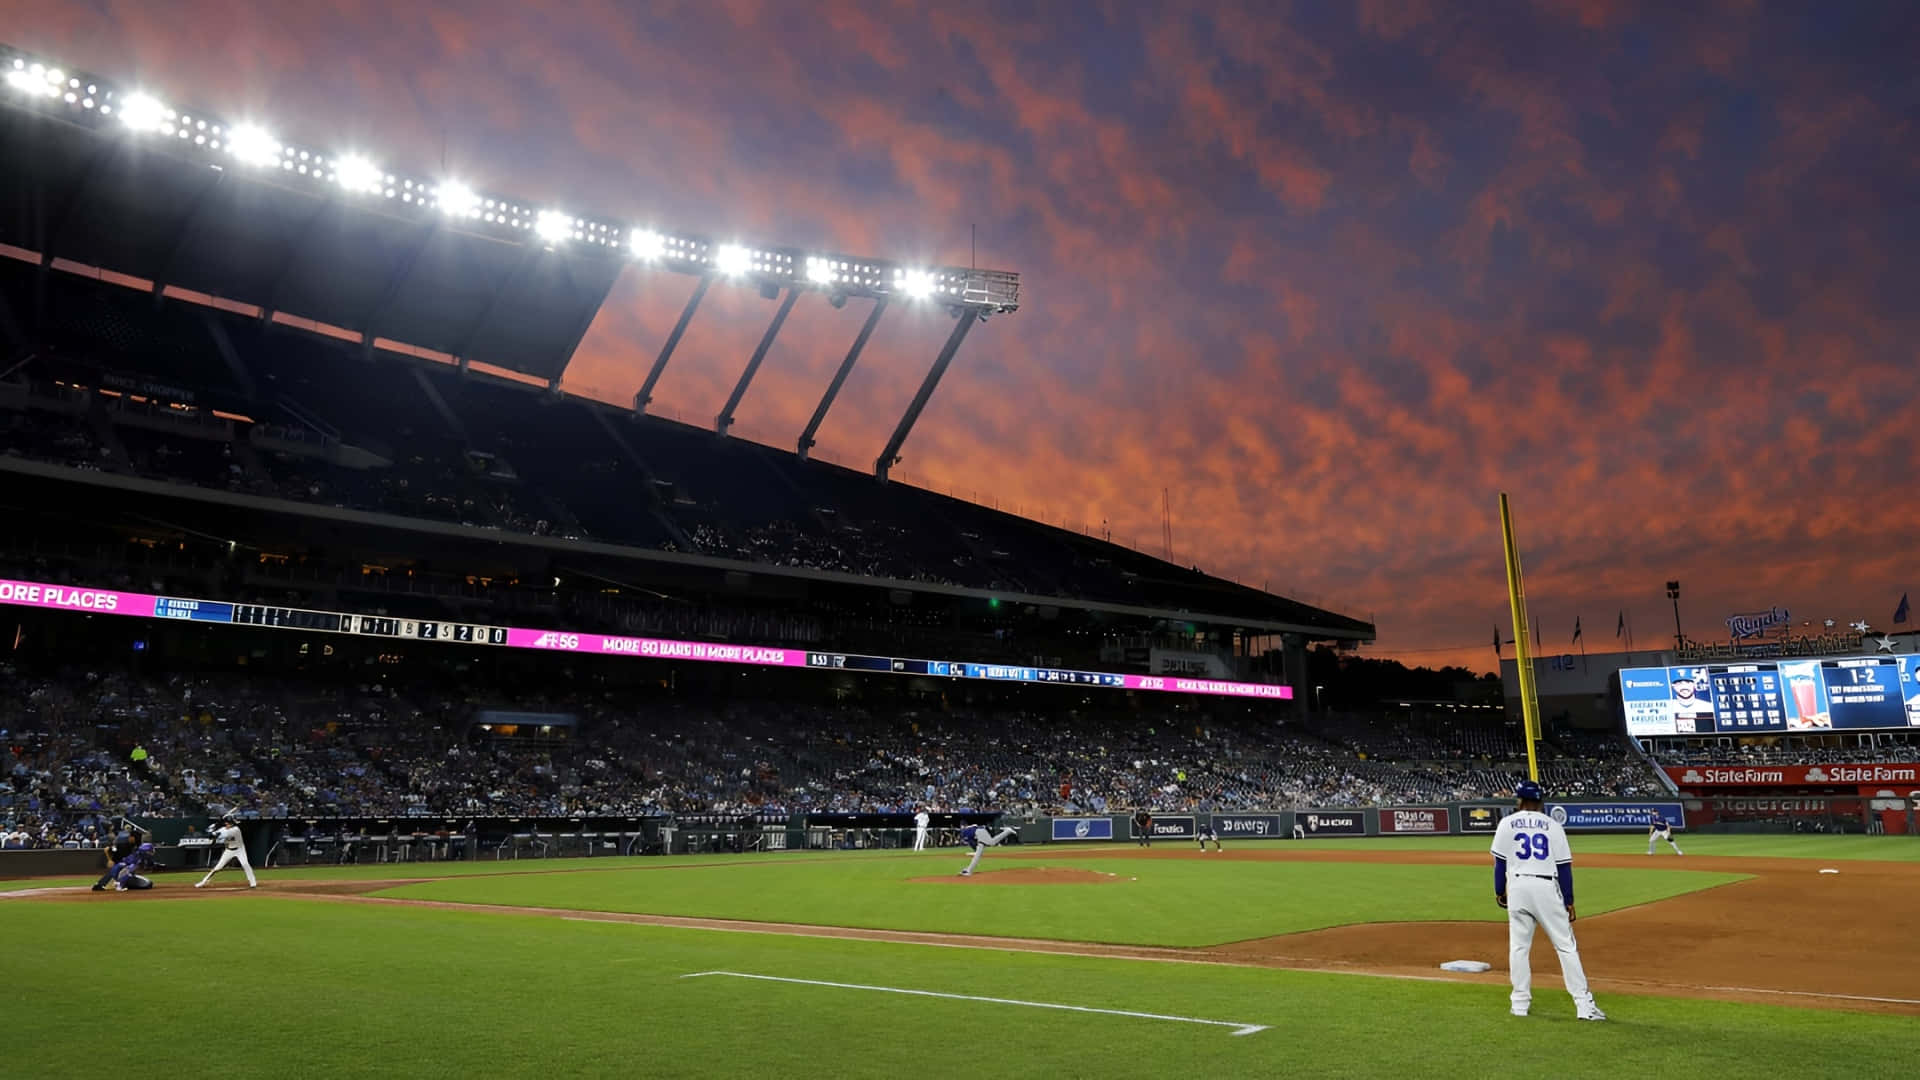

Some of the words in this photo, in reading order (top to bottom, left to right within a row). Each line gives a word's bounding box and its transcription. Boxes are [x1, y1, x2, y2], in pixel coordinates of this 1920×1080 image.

[43, 587, 118, 610] PLACES
[424, 623, 433, 638] 2
[442, 625, 449, 637] S
[459, 626, 468, 640] 2
[560, 633, 579, 649] 5G
[603, 639, 640, 653] MORE
[708, 646, 740, 659] MORE
[742, 648, 784, 662] PLACES
[1850, 668, 1876, 684] 1-2
[1513, 832, 1550, 860] 39
